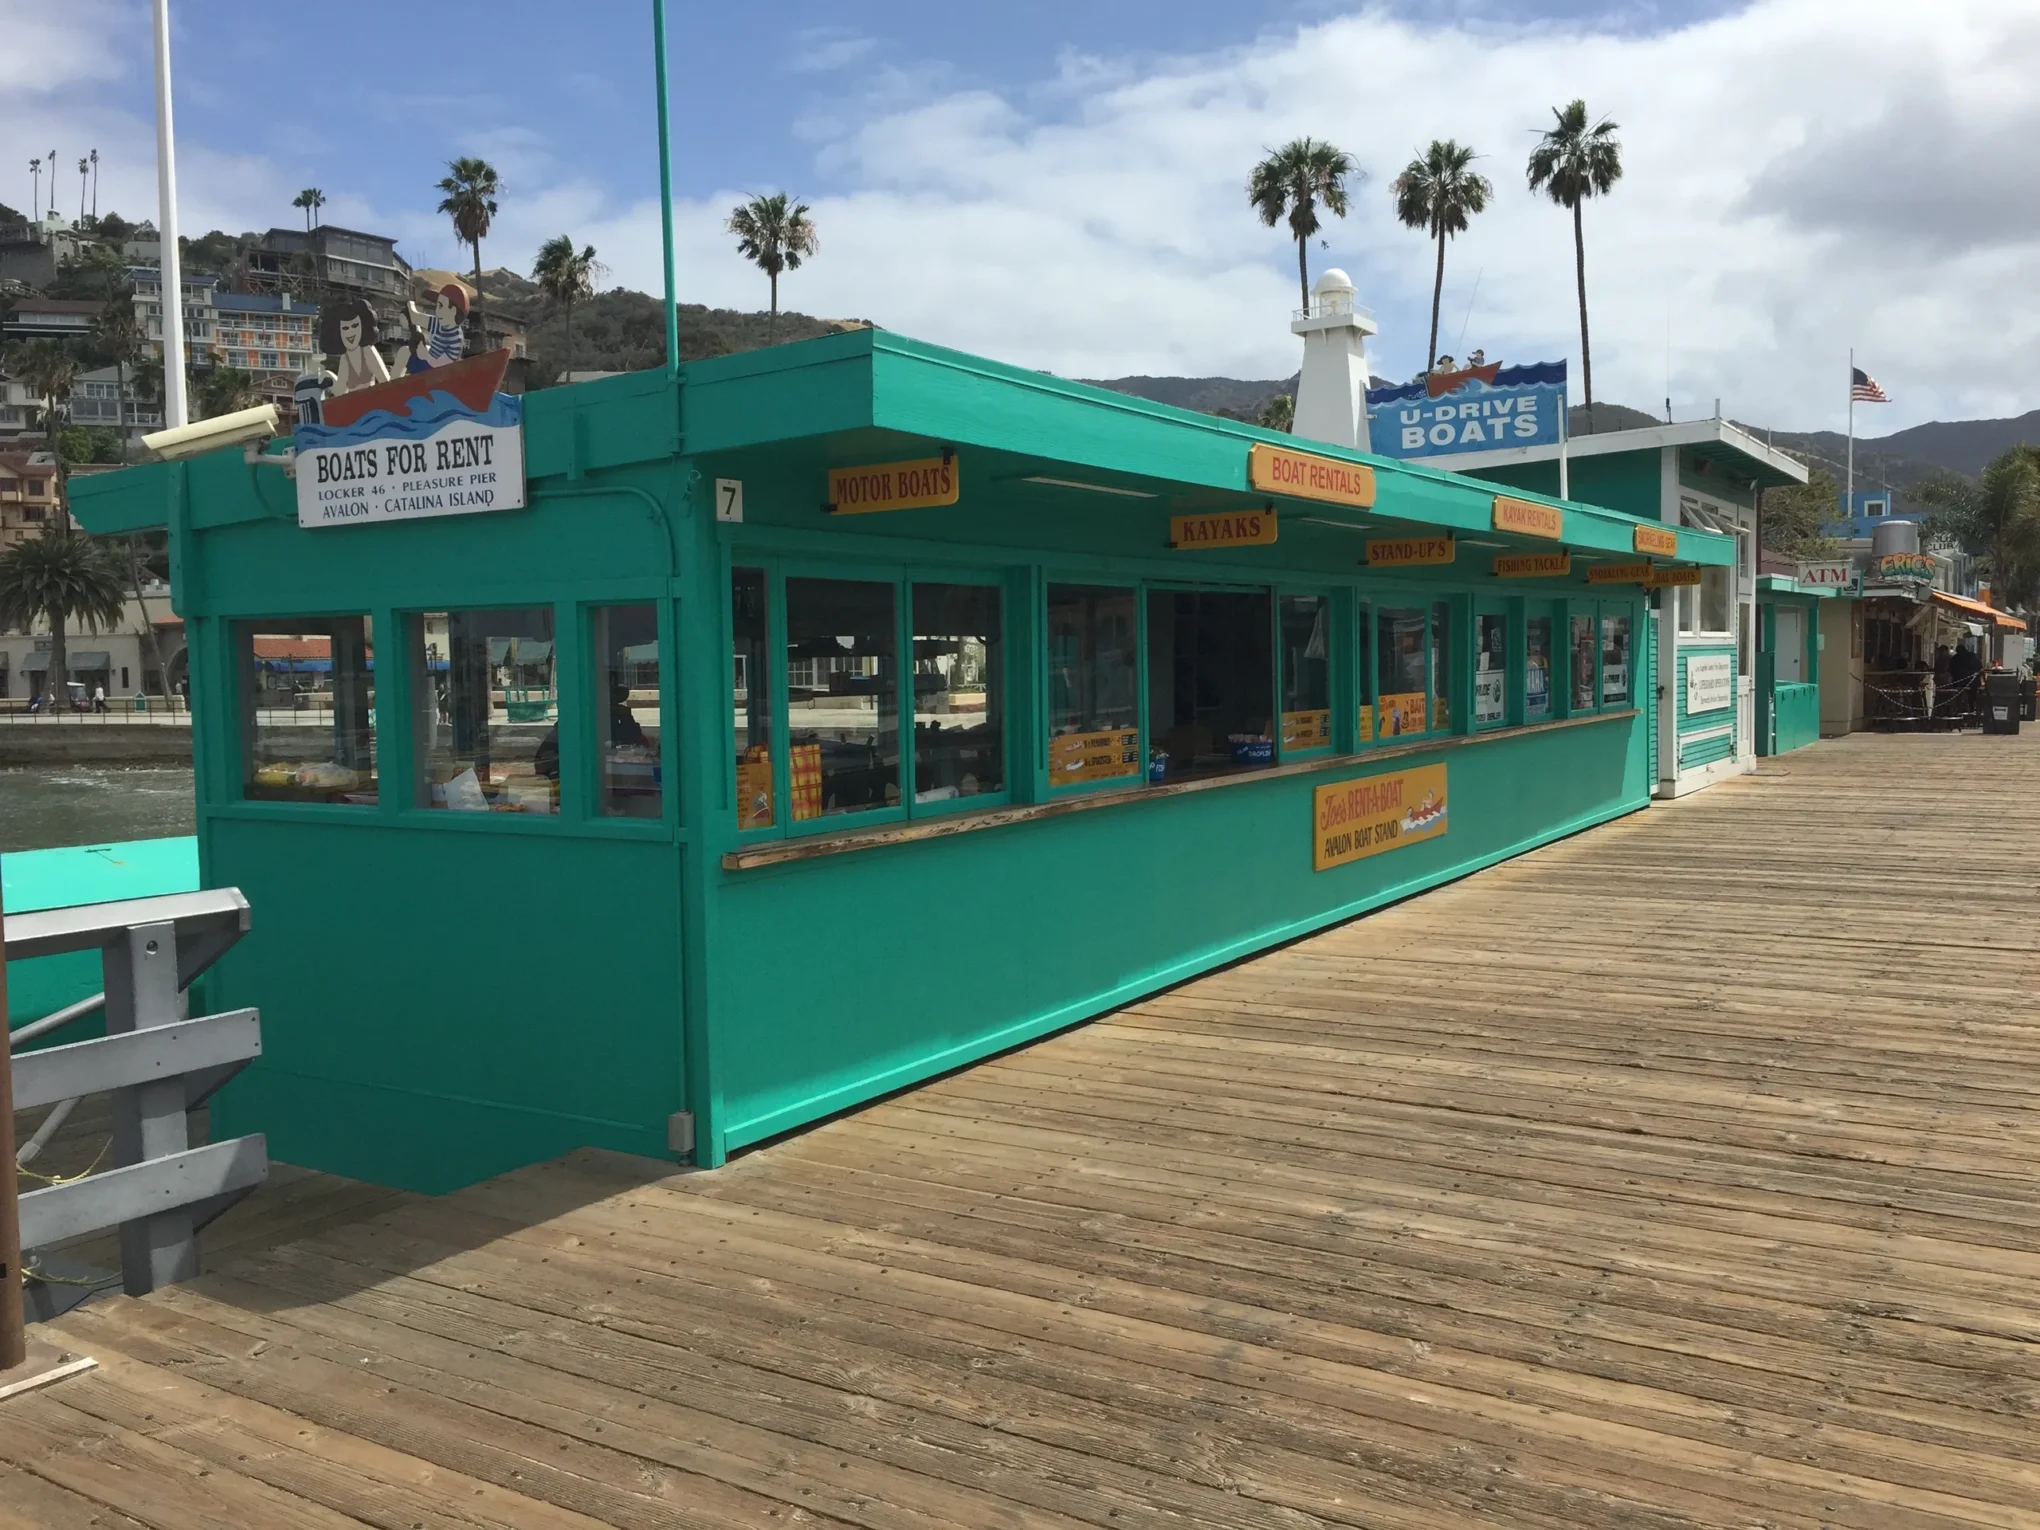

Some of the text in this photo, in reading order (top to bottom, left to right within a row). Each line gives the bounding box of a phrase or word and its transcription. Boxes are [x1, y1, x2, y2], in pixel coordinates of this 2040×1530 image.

[1400, 395, 1538, 425] U-DRIVE
[1401, 414, 1539, 450] BOATS
[316, 434, 494, 483] BOATS FOR RENT
[318, 471, 497, 501] LOCKER 46 PLEASURE PIER
[836, 466, 950, 505] MOTOR BOATS
[1272, 456, 1361, 496] BOAT RENTALS
[322, 489, 494, 519] AVALON CATALINA ISLAND
[722, 486, 736, 515] 7
[1183, 516, 1261, 542] KAYAKS
[1503, 504, 1556, 531] KAYAK RENTALS
[1371, 541, 1446, 561] STAND-UP'S
[1497, 556, 1566, 573] FISHING TACKLE
[1802, 567, 1847, 584] ATM
[1320, 778, 1404, 831] Joe's RENT-A-BOAT
[1324, 819, 1398, 859] AVALON BOAT STAND
